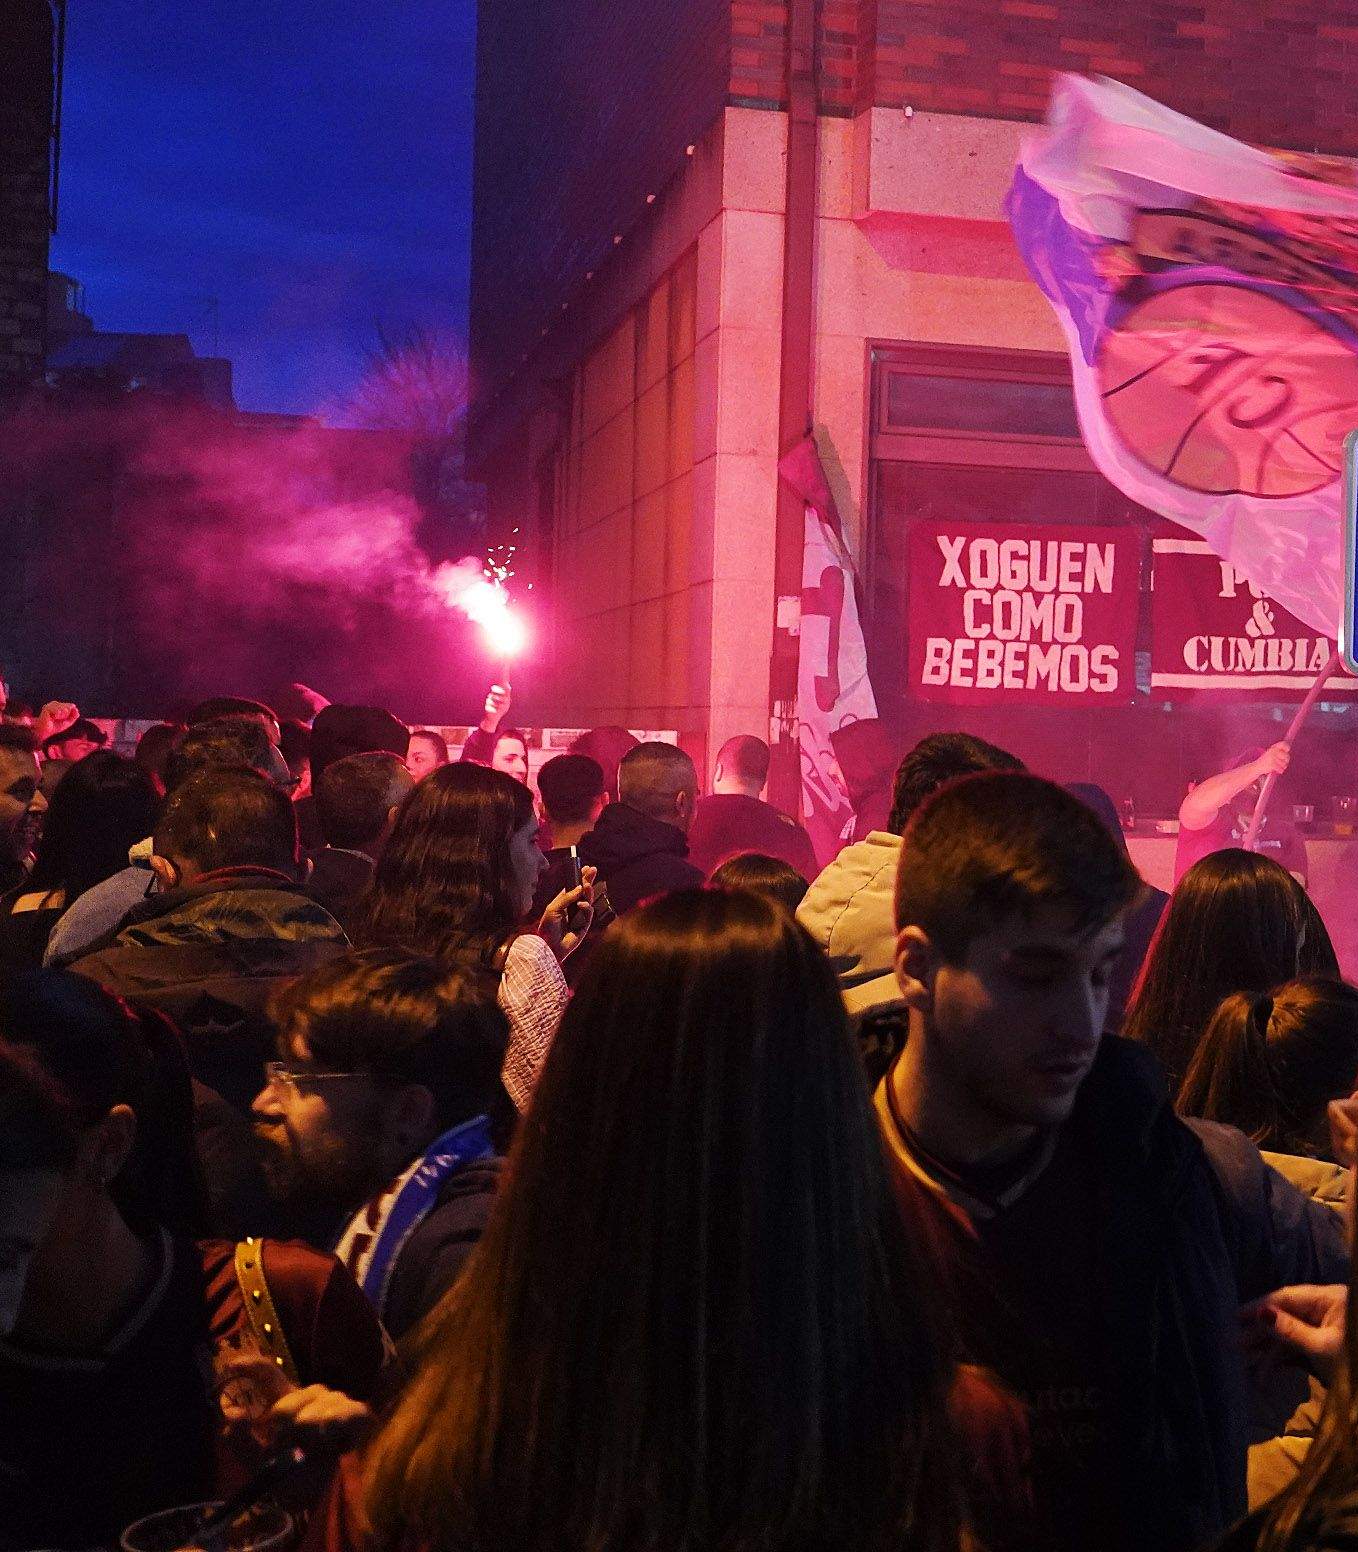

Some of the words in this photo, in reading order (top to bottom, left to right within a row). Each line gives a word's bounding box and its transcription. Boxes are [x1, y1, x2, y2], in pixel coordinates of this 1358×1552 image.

[936, 535, 1115, 593] XOGUEN
[963, 589, 1083, 643] COMO
[1245, 599, 1275, 637] &
[922, 637, 1120, 693] BEBEMOS
[1183, 635, 1330, 672] CUMBIA
